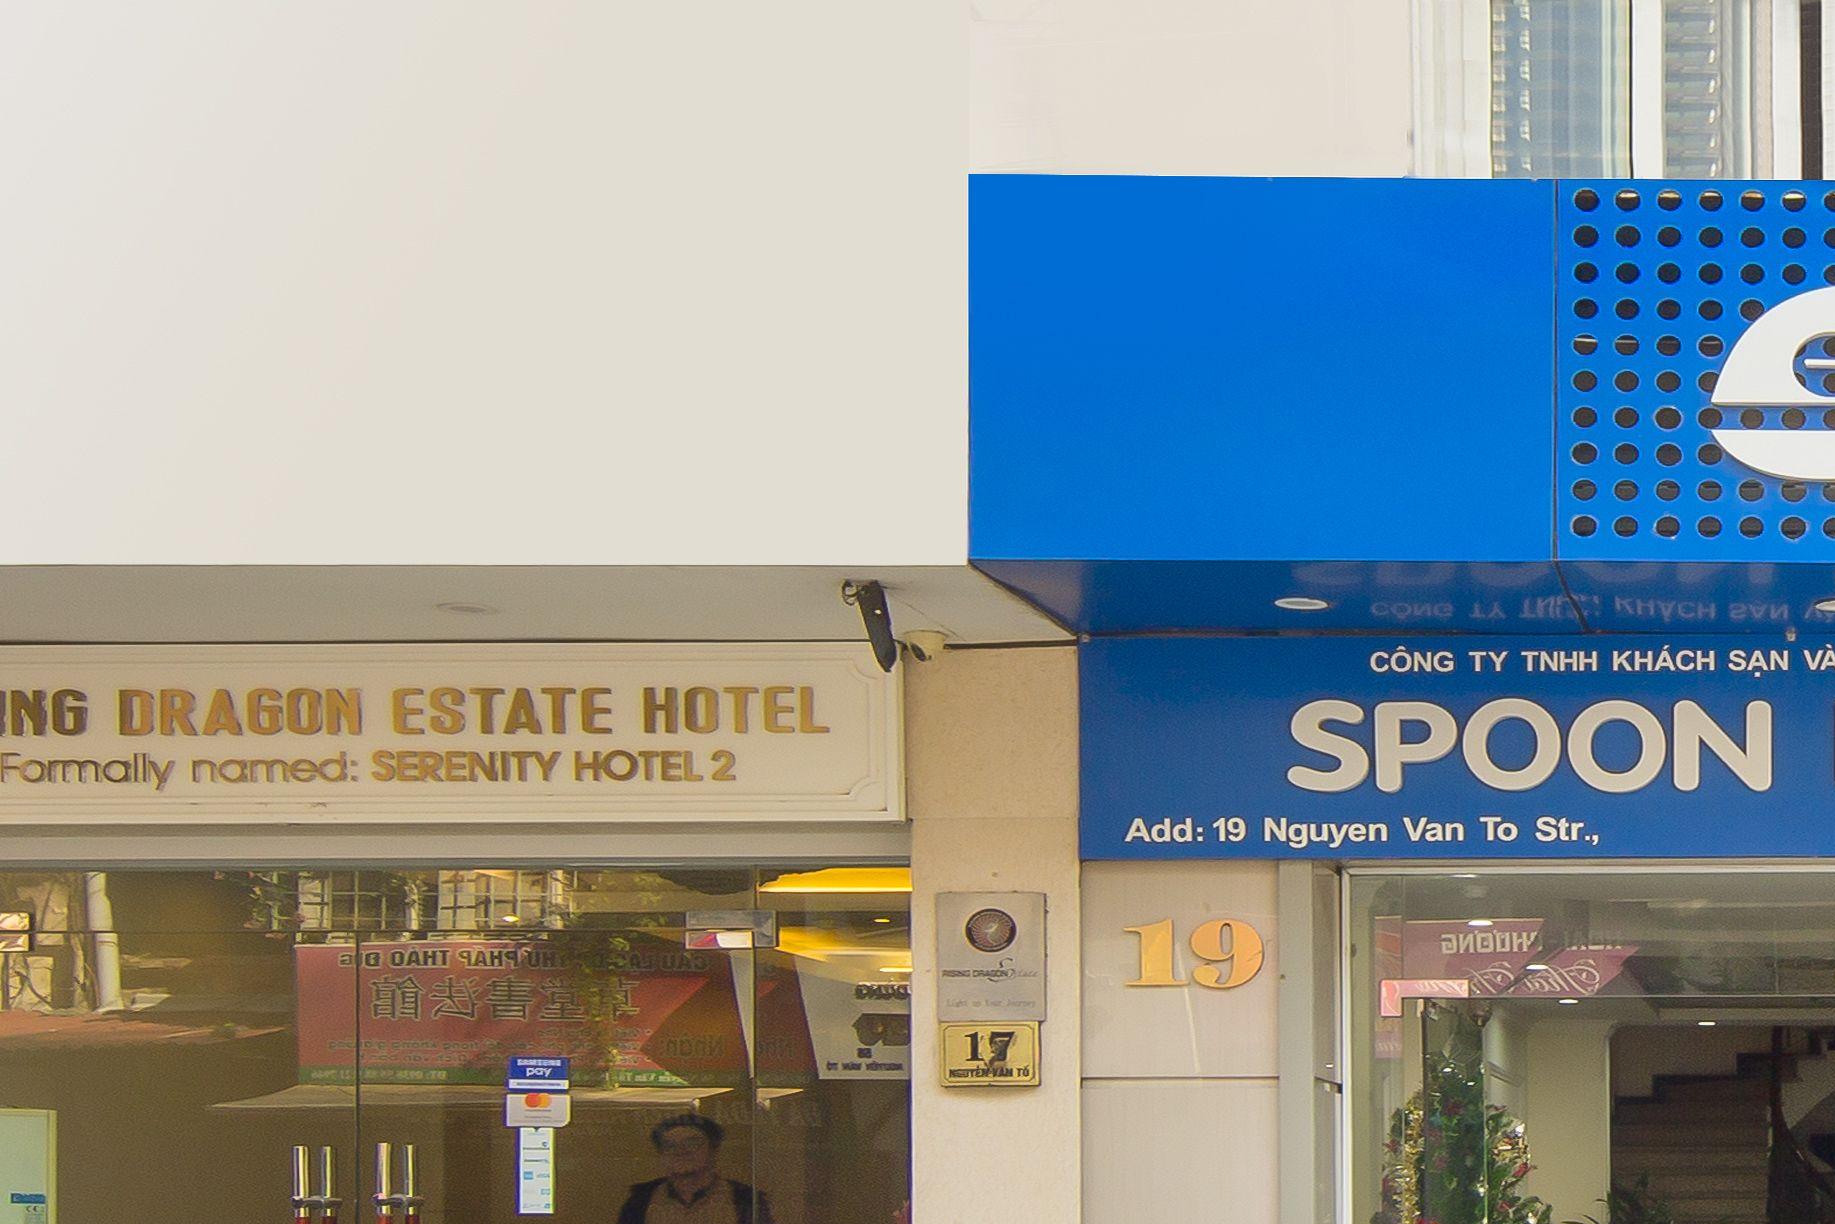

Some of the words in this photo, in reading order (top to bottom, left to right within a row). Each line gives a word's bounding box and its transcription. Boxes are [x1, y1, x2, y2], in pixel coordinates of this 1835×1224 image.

[1370, 645, 1455, 673] CÔNG
[1468, 651, 1508, 672] TY
[1521, 650, 1599, 672] TNHH
[1612, 644, 1716, 673] KHÁCH
[1728, 650, 1790, 678] SẠN
[117, 687, 363, 737] DRAGON
[391, 686, 613, 736] ESTATE
[641, 685, 832, 735] HOTEL
[1286, 697, 1773, 793] SPOON
[0, 751, 175, 792] Formally
[191, 750, 359, 784] named:
[371, 749, 562, 784] SERENITY
[573, 748, 704, 784] HOTEL
[710, 749, 738, 783] 2
[1124, 816, 1205, 844] Add:
[1212, 817, 1247, 843] 19
[1263, 817, 1389, 849] Nguyen
[1402, 817, 1465, 843] Van
[1479, 816, 1519, 843] To
[1534, 816, 1600, 847] Str.,
[1122, 918, 1267, 989] 19
[964, 1031, 1015, 1062] 17
[525, 1067, 552, 1078] pay
